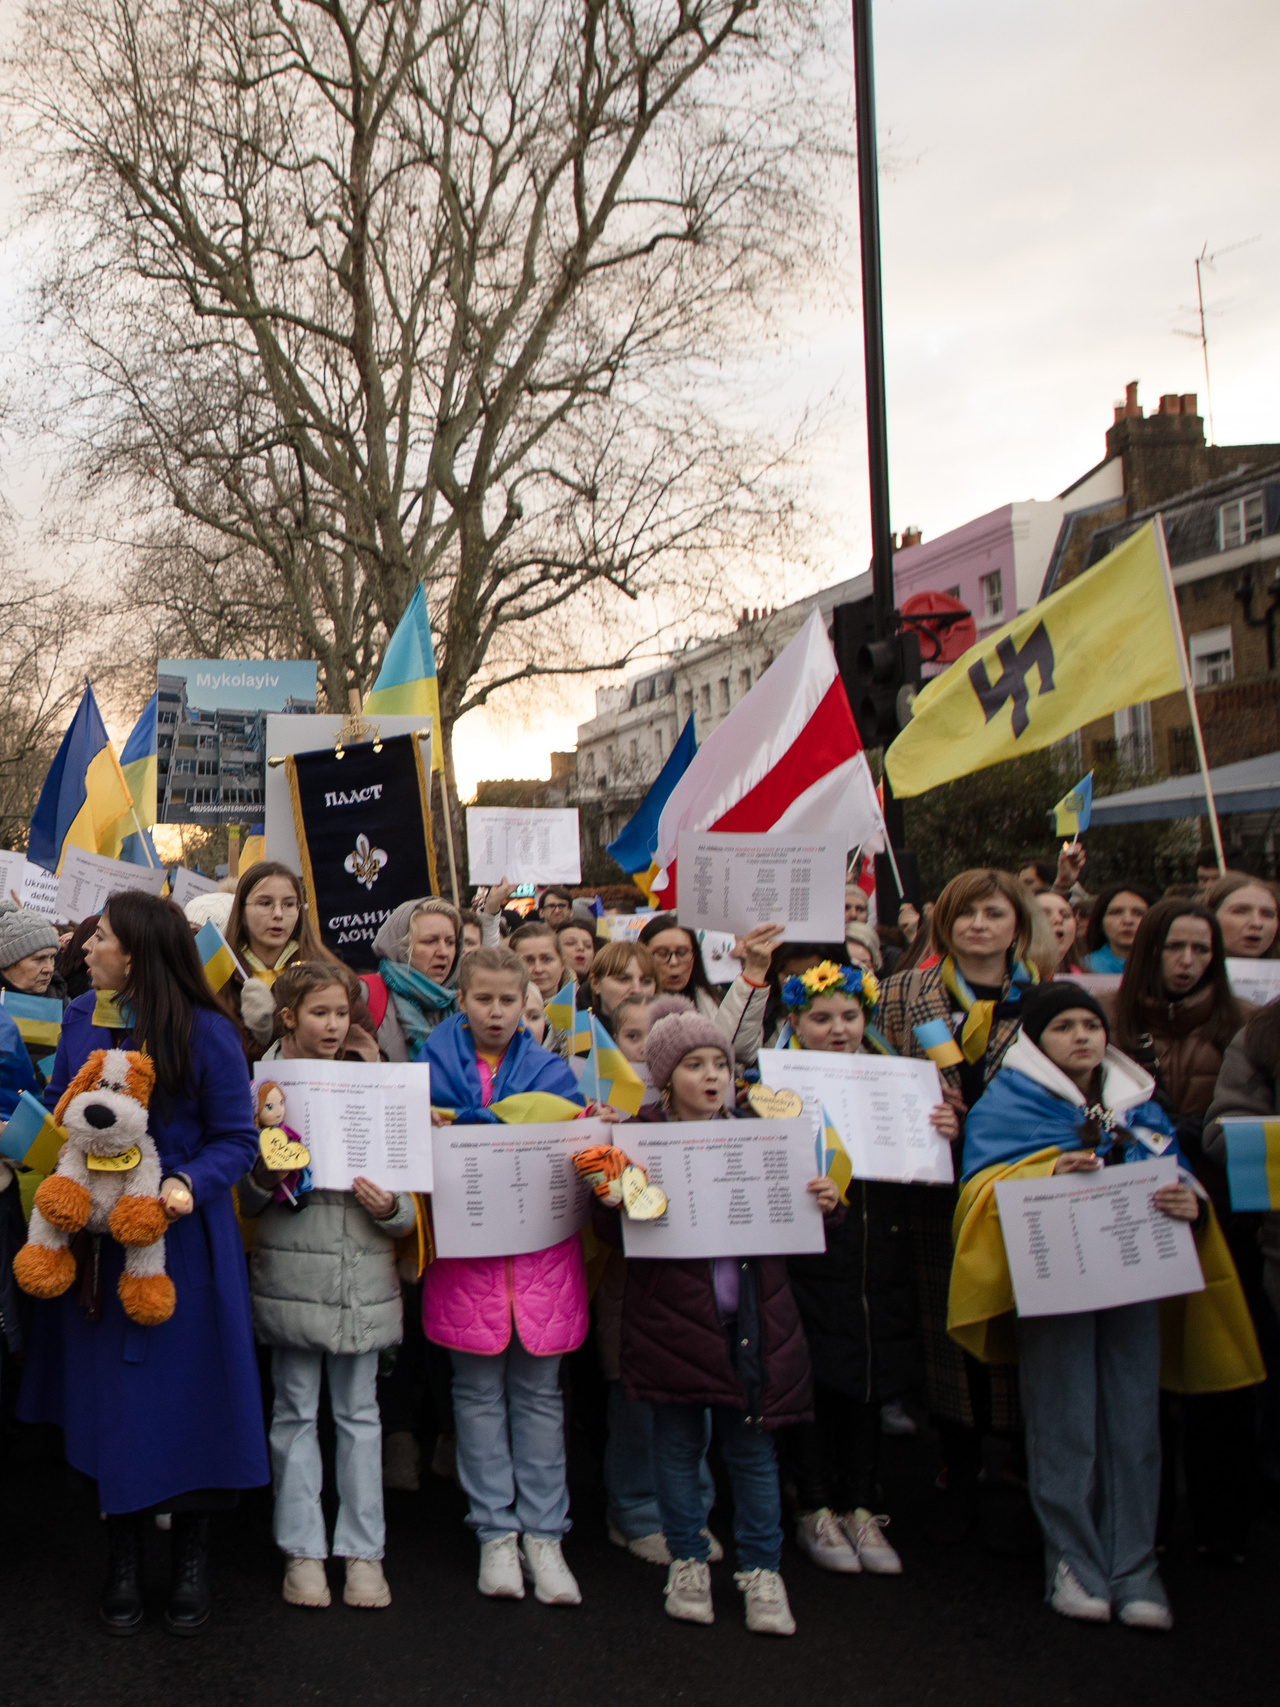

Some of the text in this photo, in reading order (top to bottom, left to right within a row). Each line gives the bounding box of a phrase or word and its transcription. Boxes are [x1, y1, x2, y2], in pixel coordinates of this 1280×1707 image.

[196, 673, 280, 691] Mykolayiv
[24, 878, 59, 892] Ukraine
[30, 892, 56, 902] defea
[328, 908, 396, 930] СТАНИ
